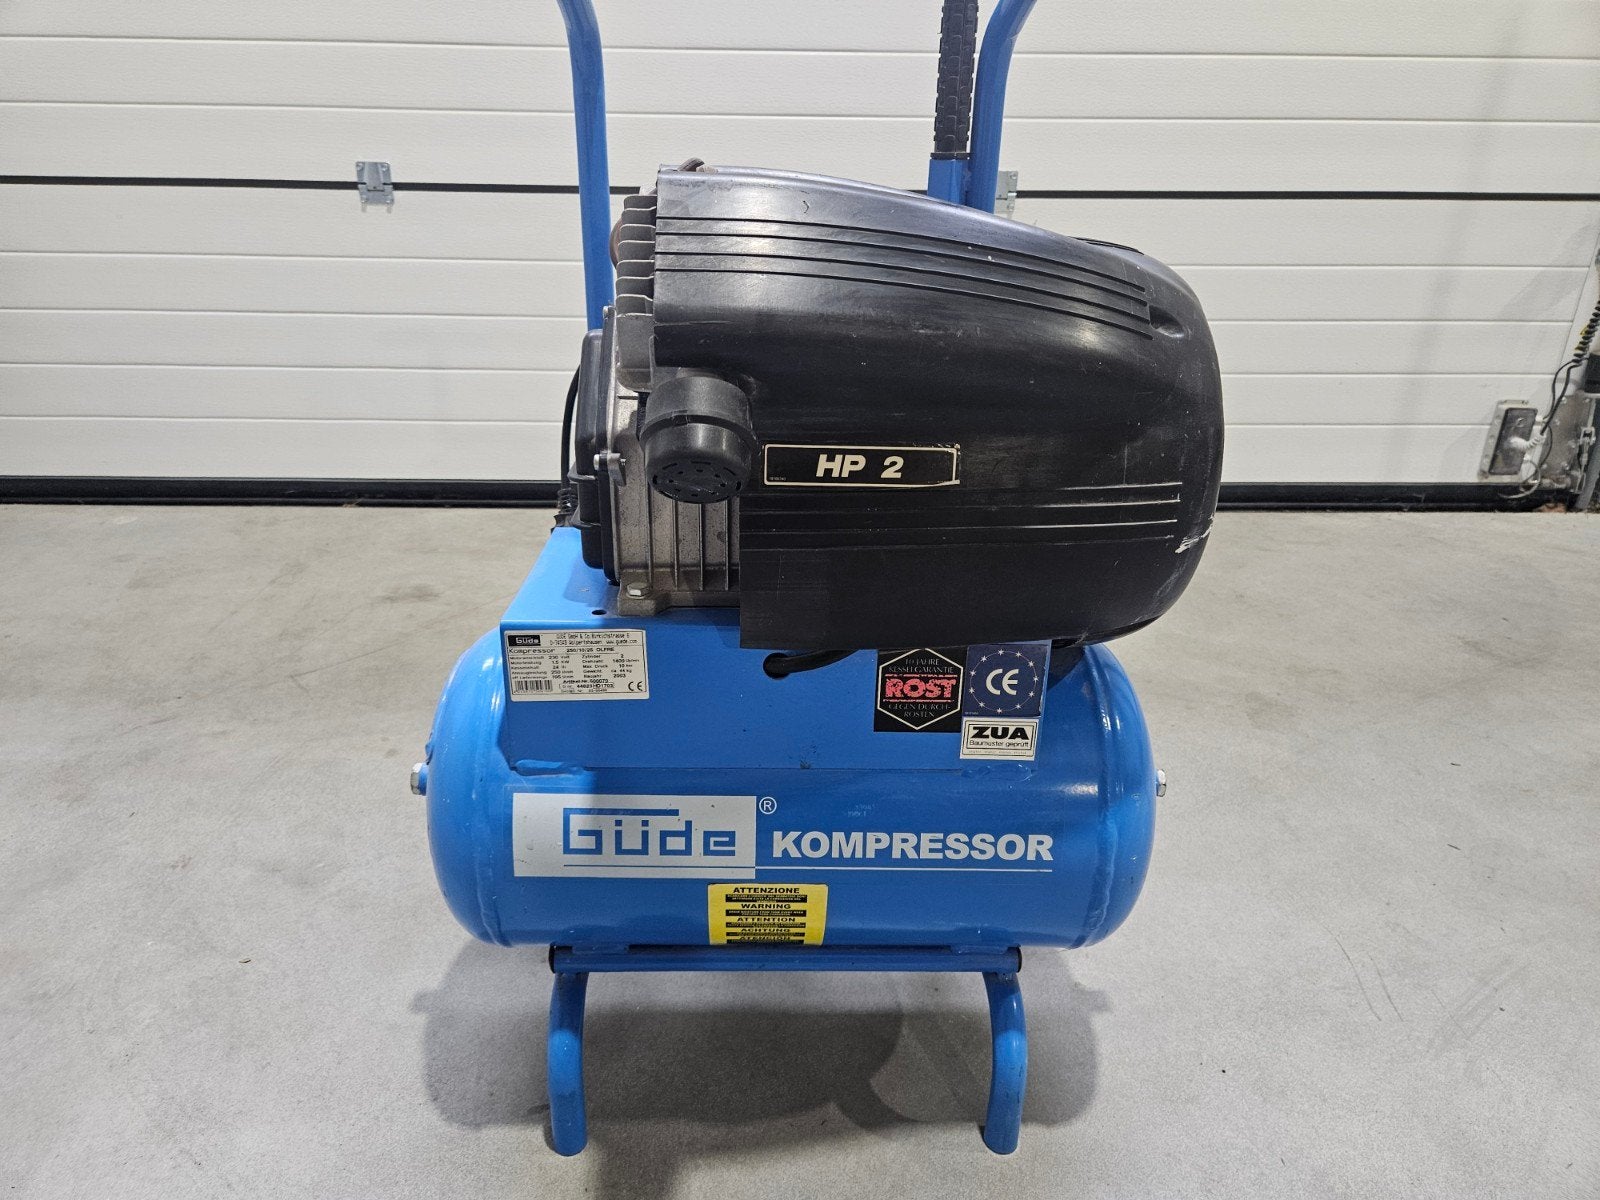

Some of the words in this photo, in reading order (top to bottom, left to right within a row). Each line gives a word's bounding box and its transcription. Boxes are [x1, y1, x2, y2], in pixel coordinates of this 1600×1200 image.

[815, 454, 866, 478] HP
[880, 456, 904, 479] 2
[916, 658, 940, 666] JAHRE
[885, 678, 957, 698] ROST
[888, 703, 917, 711] GEGEN
[970, 726, 1030, 741] ZUA
[969, 740, 1004, 748] Baumuster
[563, 807, 736, 856] Güde
[772, 831, 1054, 861] KOMPRESSOR
